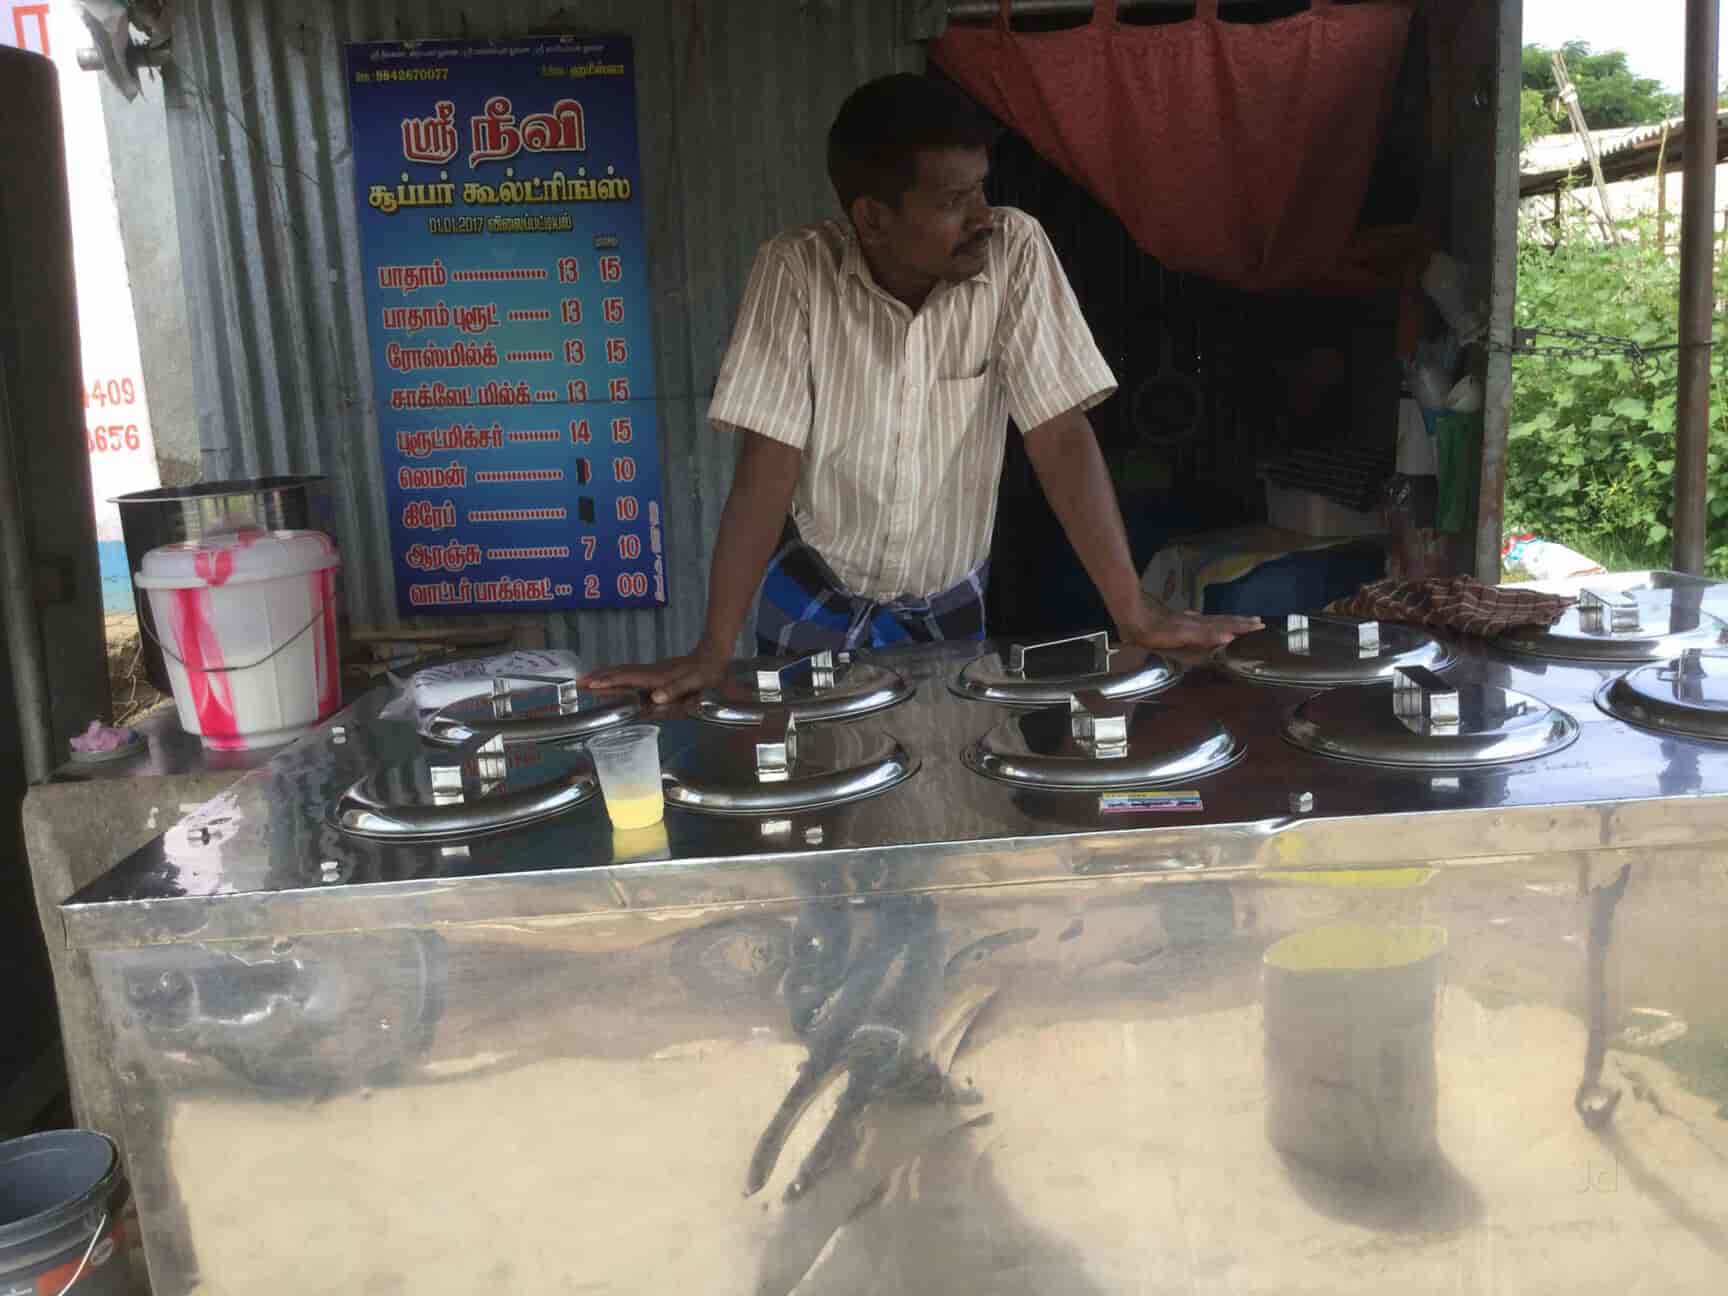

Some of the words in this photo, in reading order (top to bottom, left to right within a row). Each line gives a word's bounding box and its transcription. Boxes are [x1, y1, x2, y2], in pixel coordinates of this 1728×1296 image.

[368, 172, 455, 212] சூப்பர்
[378, 261, 446, 295] பாதாம்
[558, 257, 578, 283] 13
[600, 257, 622, 282] 15
[383, 302, 450, 336] பாதாம்
[560, 298, 582, 324] 13
[604, 298, 624, 322] 15
[564, 340, 584, 364] 13
[606, 338, 628, 363] 15
[568, 381, 588, 403] 13
[610, 380, 629, 402] 15
[570, 420, 592, 444] 14
[612, 418, 632, 443] 15
[398, 462, 466, 489] லெமன்
[613, 458, 635, 481] 10
[617, 496, 638, 520] 10
[406, 540, 482, 571] ஆரஞ்சு
[580, 536, 596, 560] 7
[619, 536, 640, 559] 10
[409, 578, 471, 606] வாட்டர்
[584, 575, 600, 598] 2
[618, 572, 647, 596] 00
